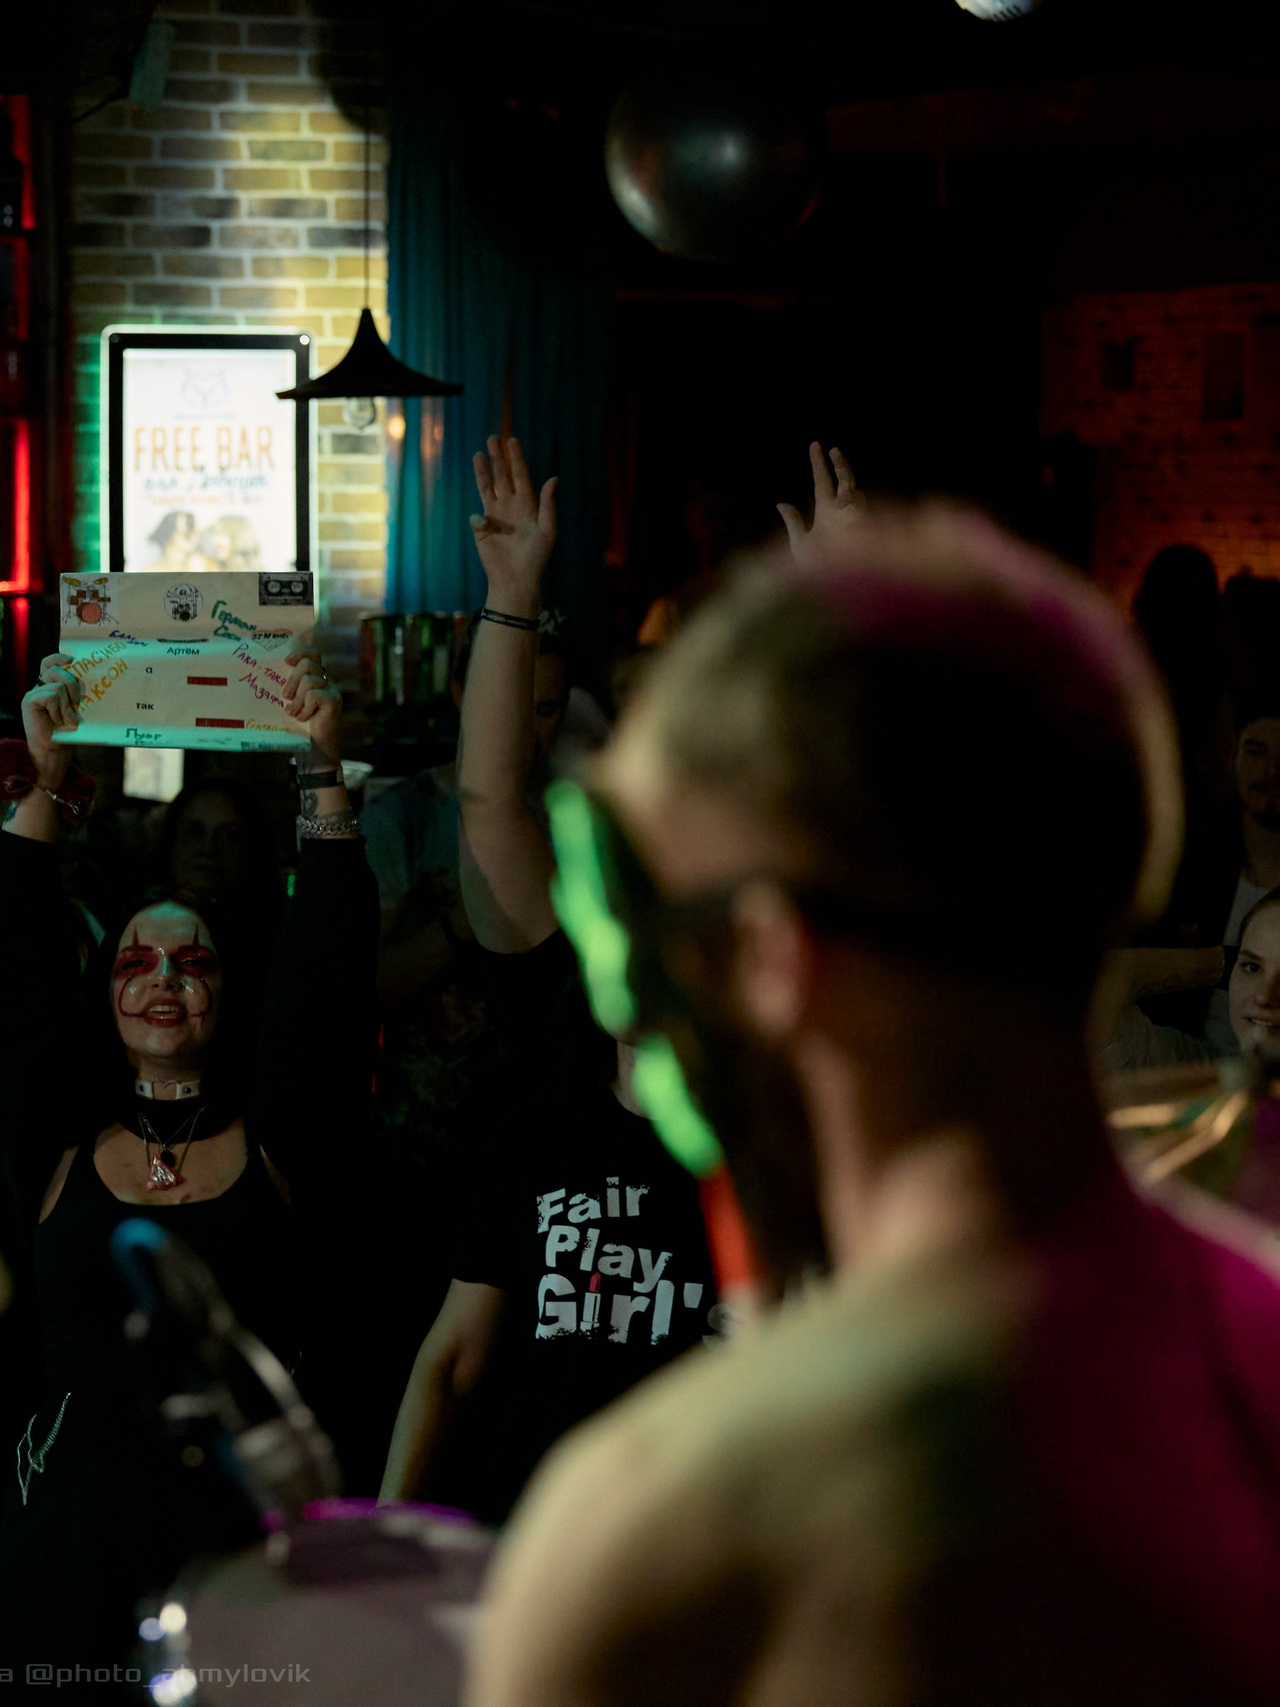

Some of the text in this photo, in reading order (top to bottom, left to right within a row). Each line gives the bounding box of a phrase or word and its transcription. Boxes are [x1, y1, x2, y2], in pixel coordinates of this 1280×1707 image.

[133, 425, 275, 473] FREE BAR
[166, 646, 200, 656] Артём
[136, 702, 154, 710] так
[536, 1176, 651, 1234] Fair
[545, 1225, 673, 1294] Play
